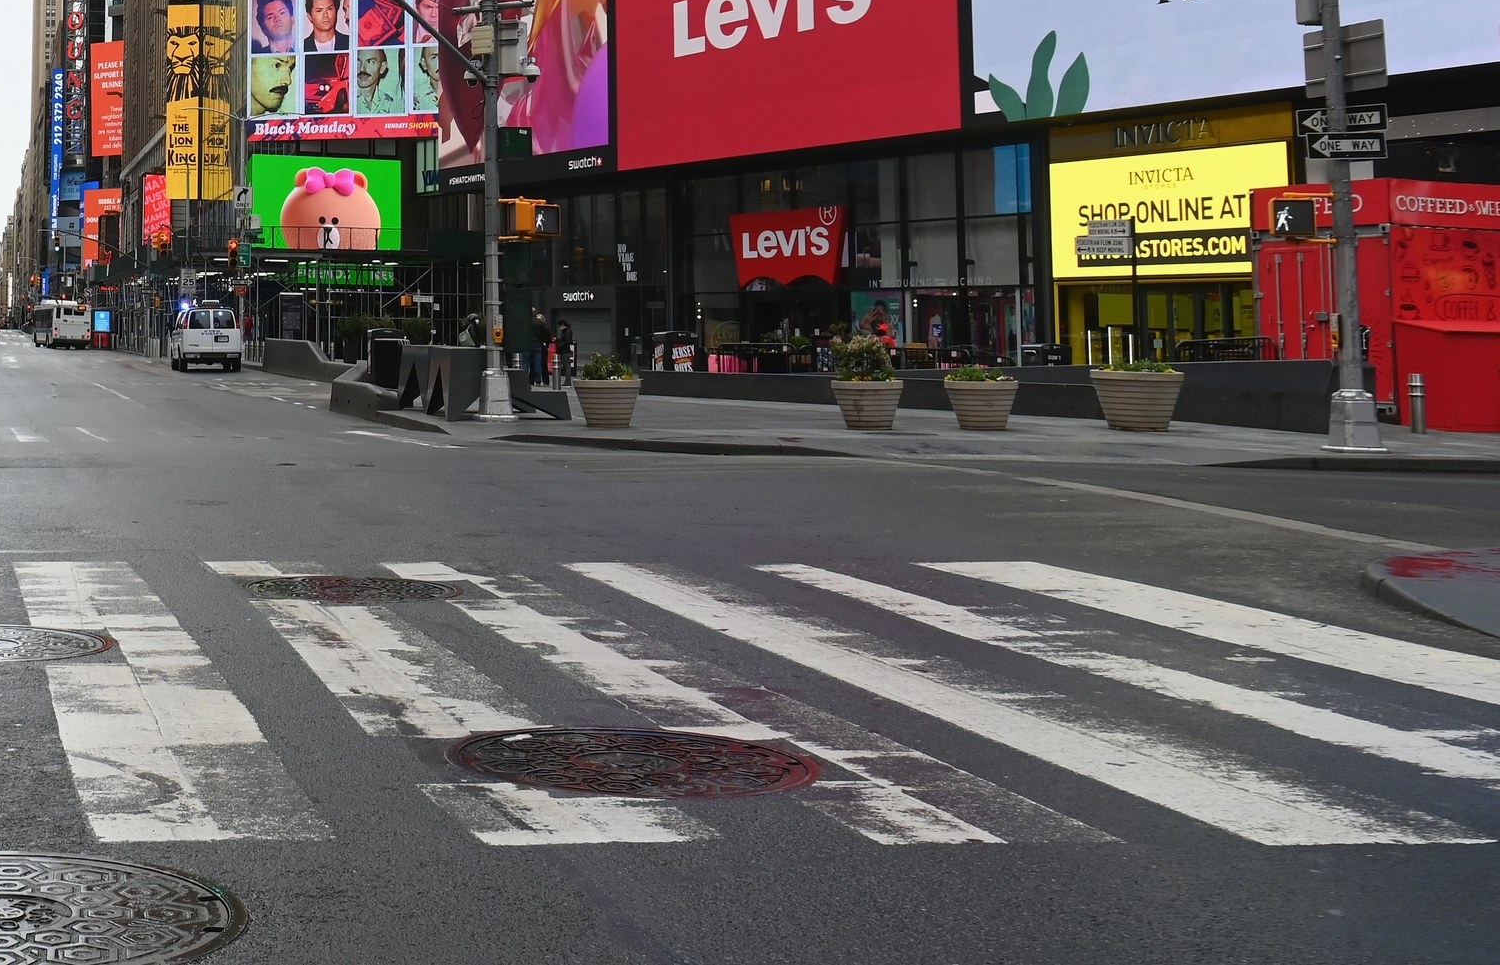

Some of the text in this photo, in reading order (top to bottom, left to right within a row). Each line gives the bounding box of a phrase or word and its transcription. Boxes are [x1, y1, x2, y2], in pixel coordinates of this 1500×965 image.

[97, 61, 119, 70] PLEASE
[93, 71, 120, 80] SUPPORT
[53, 73, 64, 145] 212 2349
[1347, 113, 1375, 124] WAY
[172, 123, 190, 133] THE
[254, 121, 408, 135] Black Monday SUNDAYS
[1113, 116, 1215, 150] INVICTA
[169, 133, 193, 149] LION
[1319, 140, 1376, 151] ONE WAY
[167, 149, 197, 167] KING
[568, 156, 597, 170] swatch
[1128, 166, 1195, 186] INVICTA
[1078, 194, 1247, 227] SHOP ONLINE AT
[1395, 194, 1468, 215] COFFEED
[617, 244, 627, 253] NO
[622, 263, 632, 272] TO
[626, 272, 638, 282] DIE
[959, 277, 992, 286] CHINO
[562, 290, 591, 302] swatch
[1443, 299, 1497, 321] COFFEE &
[671, 344, 695, 360] JERSEY
